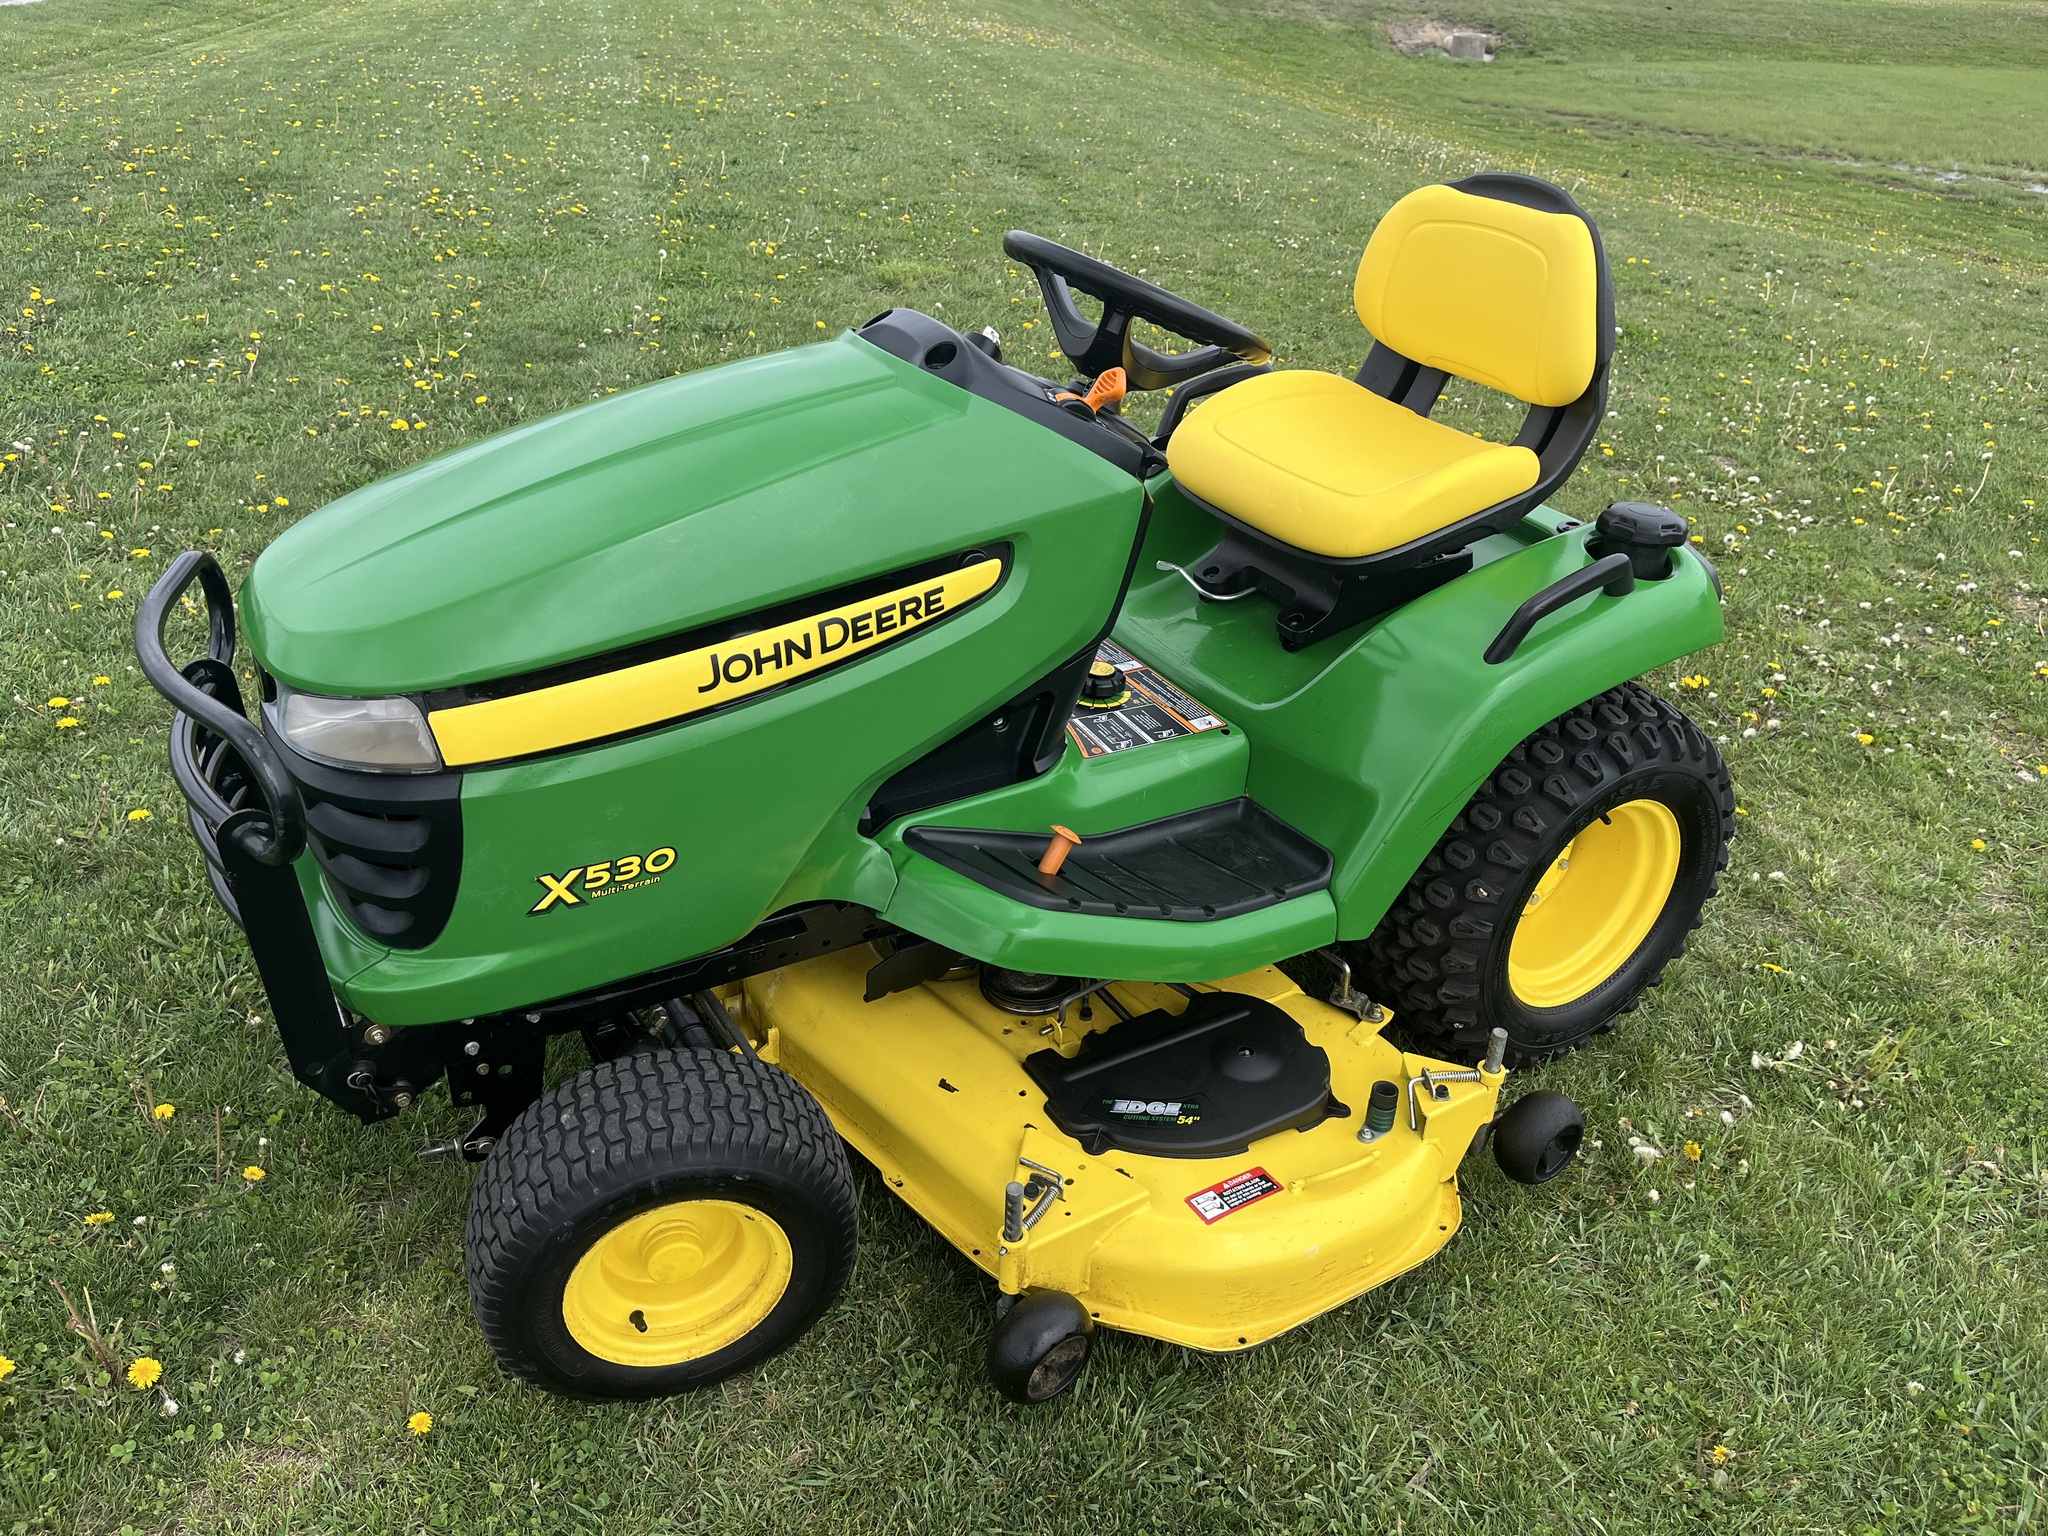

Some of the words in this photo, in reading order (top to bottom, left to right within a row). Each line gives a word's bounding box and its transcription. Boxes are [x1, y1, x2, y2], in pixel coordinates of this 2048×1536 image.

[698, 632, 812, 693] JOHN
[817, 586, 945, 654] DEERE
[530, 847, 677, 914] X530
[591, 876, 661, 899] Multi-Terrain
[1109, 1099, 1182, 1116] EDGE
[1176, 1115, 1200, 1125] 54"
[1227, 1172, 1253, 1186] DANGER
